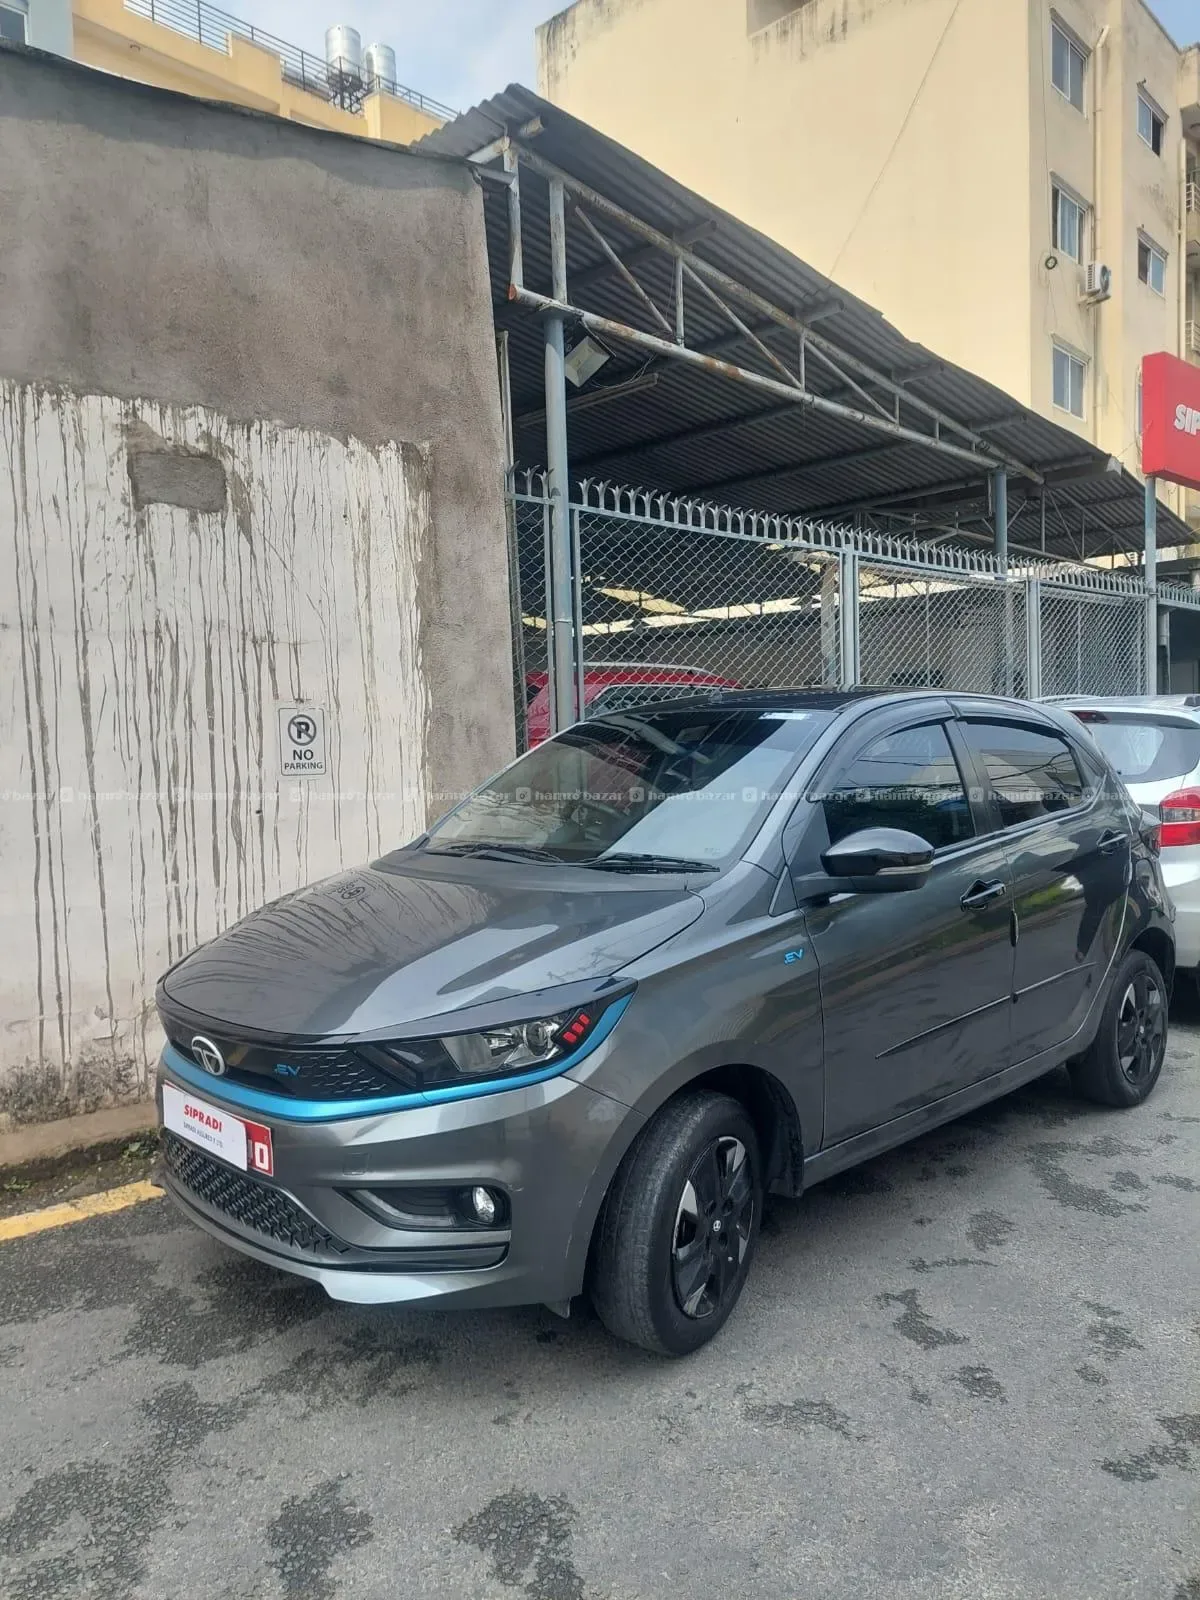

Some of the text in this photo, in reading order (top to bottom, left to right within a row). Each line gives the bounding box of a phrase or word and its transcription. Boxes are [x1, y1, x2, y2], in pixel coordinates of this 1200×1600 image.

[293, 749, 314, 761] NO
[284, 761, 323, 770] PARKING
[784, 948, 803, 964] EV
[274, 1063, 300, 1076] EV
[183, 1104, 222, 1133] SIPRADI
